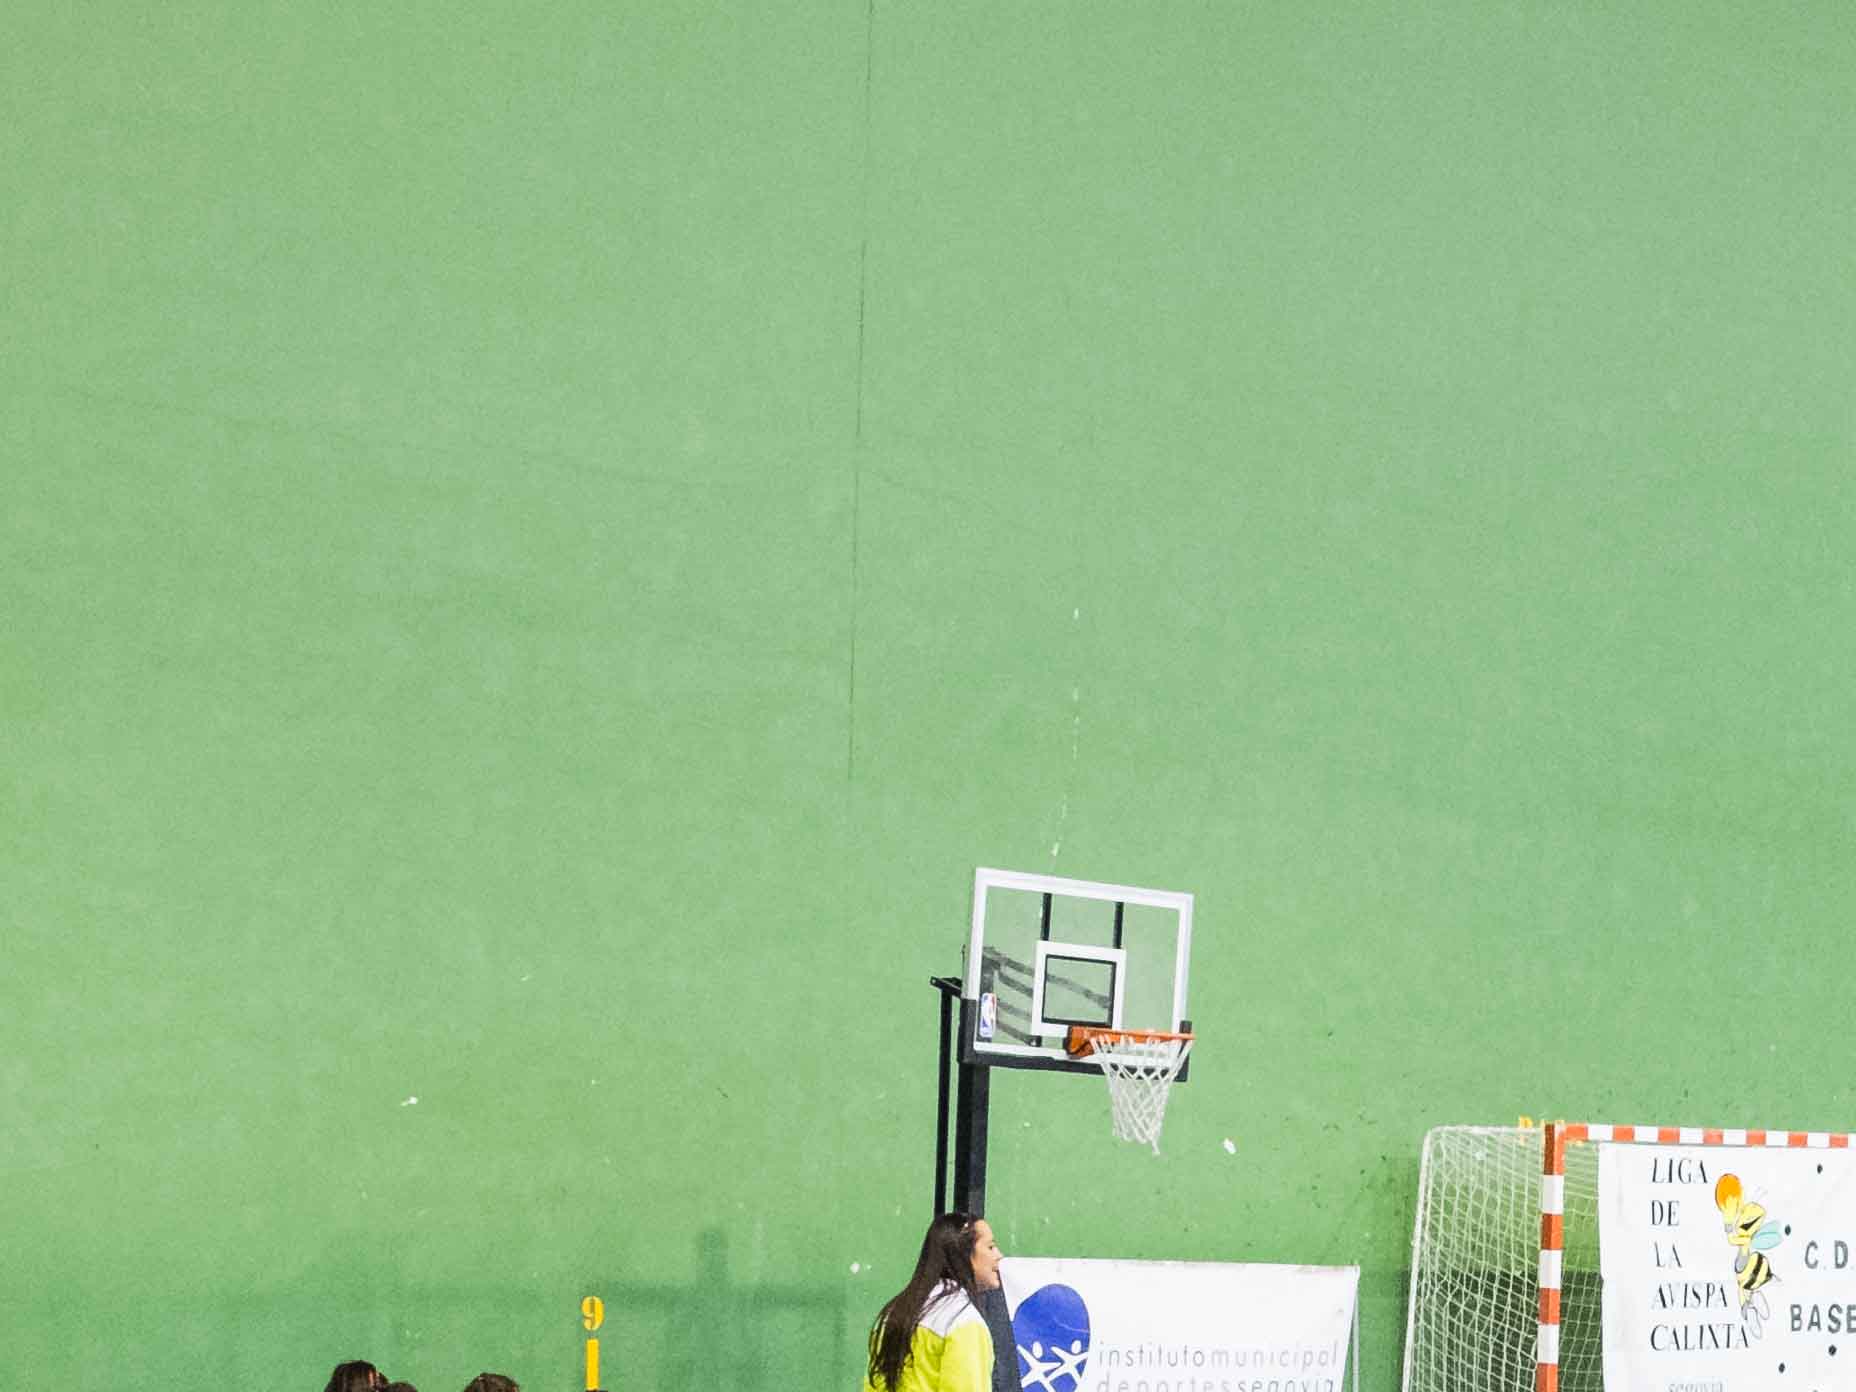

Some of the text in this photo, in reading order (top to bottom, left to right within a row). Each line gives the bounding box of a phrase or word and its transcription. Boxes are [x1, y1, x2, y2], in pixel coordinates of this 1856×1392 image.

[1651, 1157, 1708, 1184] LIGA
[1650, 1199, 1680, 1226] DE
[1654, 1241, 1682, 1268] LA
[1651, 1282, 1728, 1309] AVISPA
[581, 1296, 604, 1331] 9
